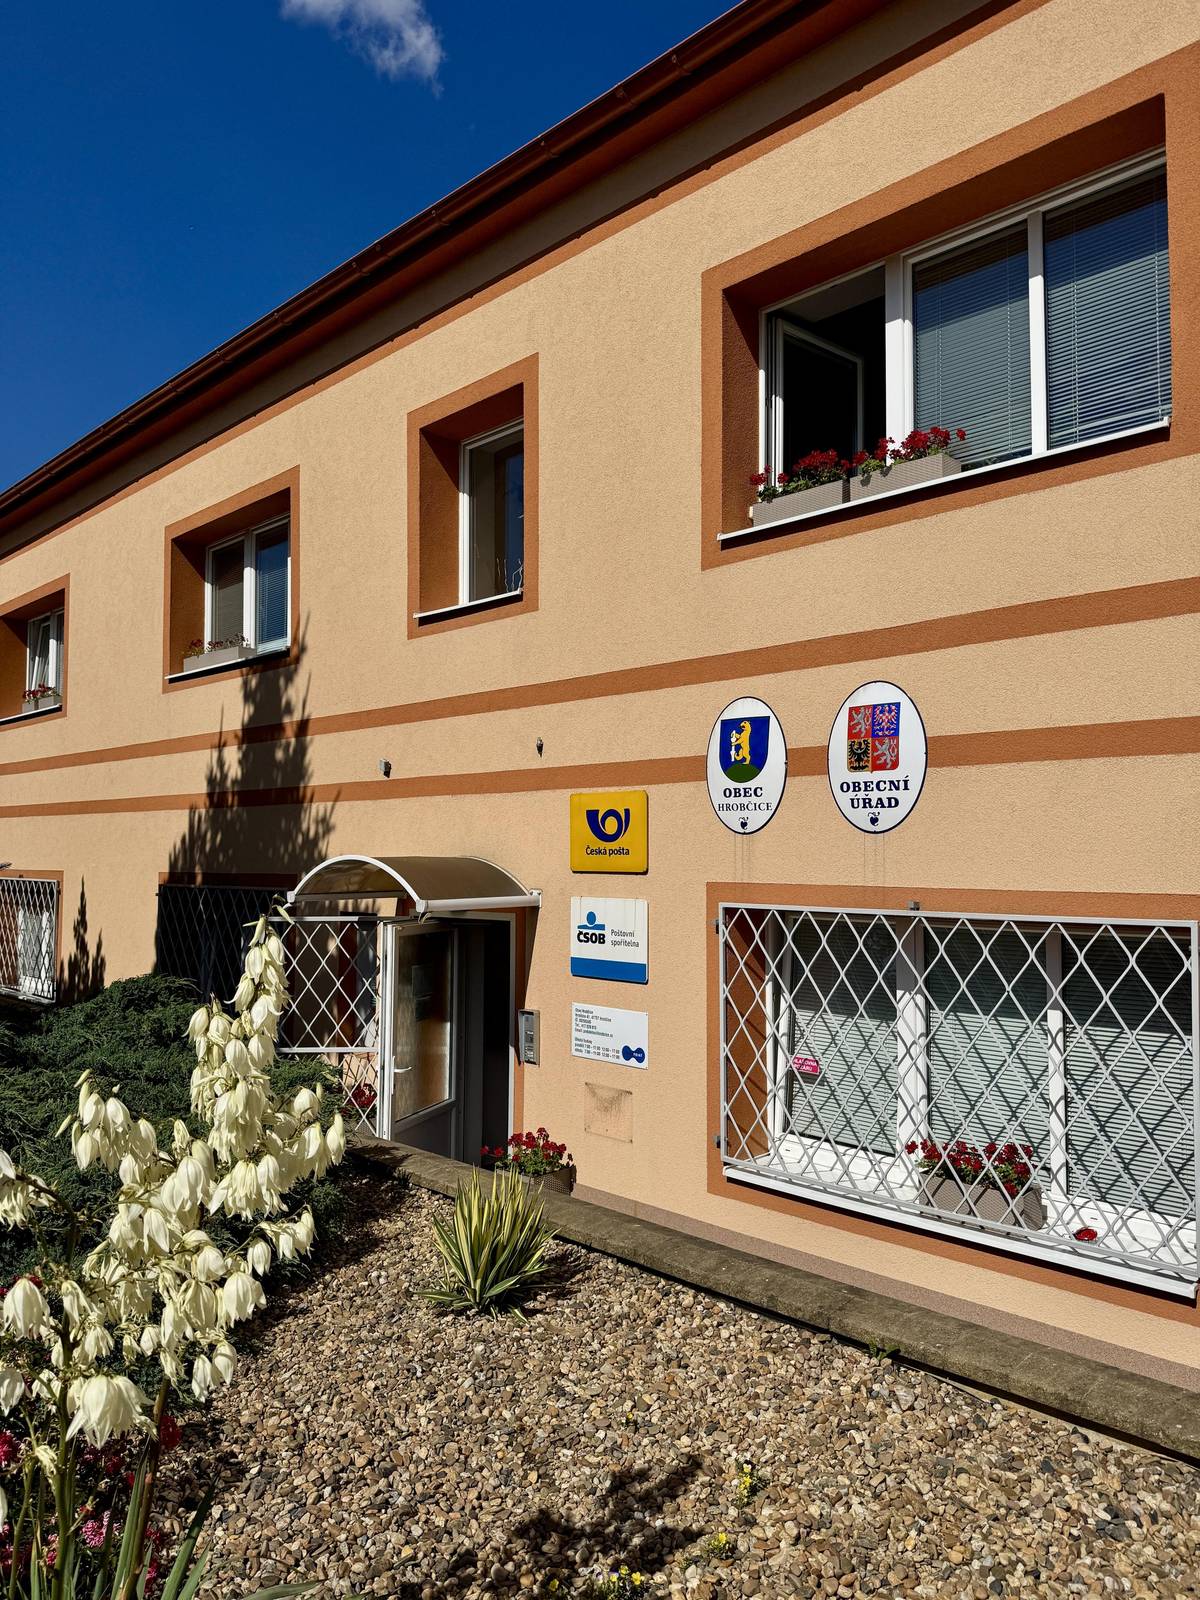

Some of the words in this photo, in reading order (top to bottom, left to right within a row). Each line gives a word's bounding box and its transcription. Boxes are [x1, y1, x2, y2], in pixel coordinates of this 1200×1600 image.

[840, 775, 909, 793] OBECNÍ
[723, 786, 763, 798] OBEC
[717, 800, 773, 812] HROBČICE
[850, 793, 900, 809] ÚŘAD
[585, 845, 607, 856] Česká
[608, 847, 630, 857] pošta
[577, 930, 606, 944] ČSOB
[610, 929, 635, 938] Poštovní
[610, 939, 640, 948] spořitelna
